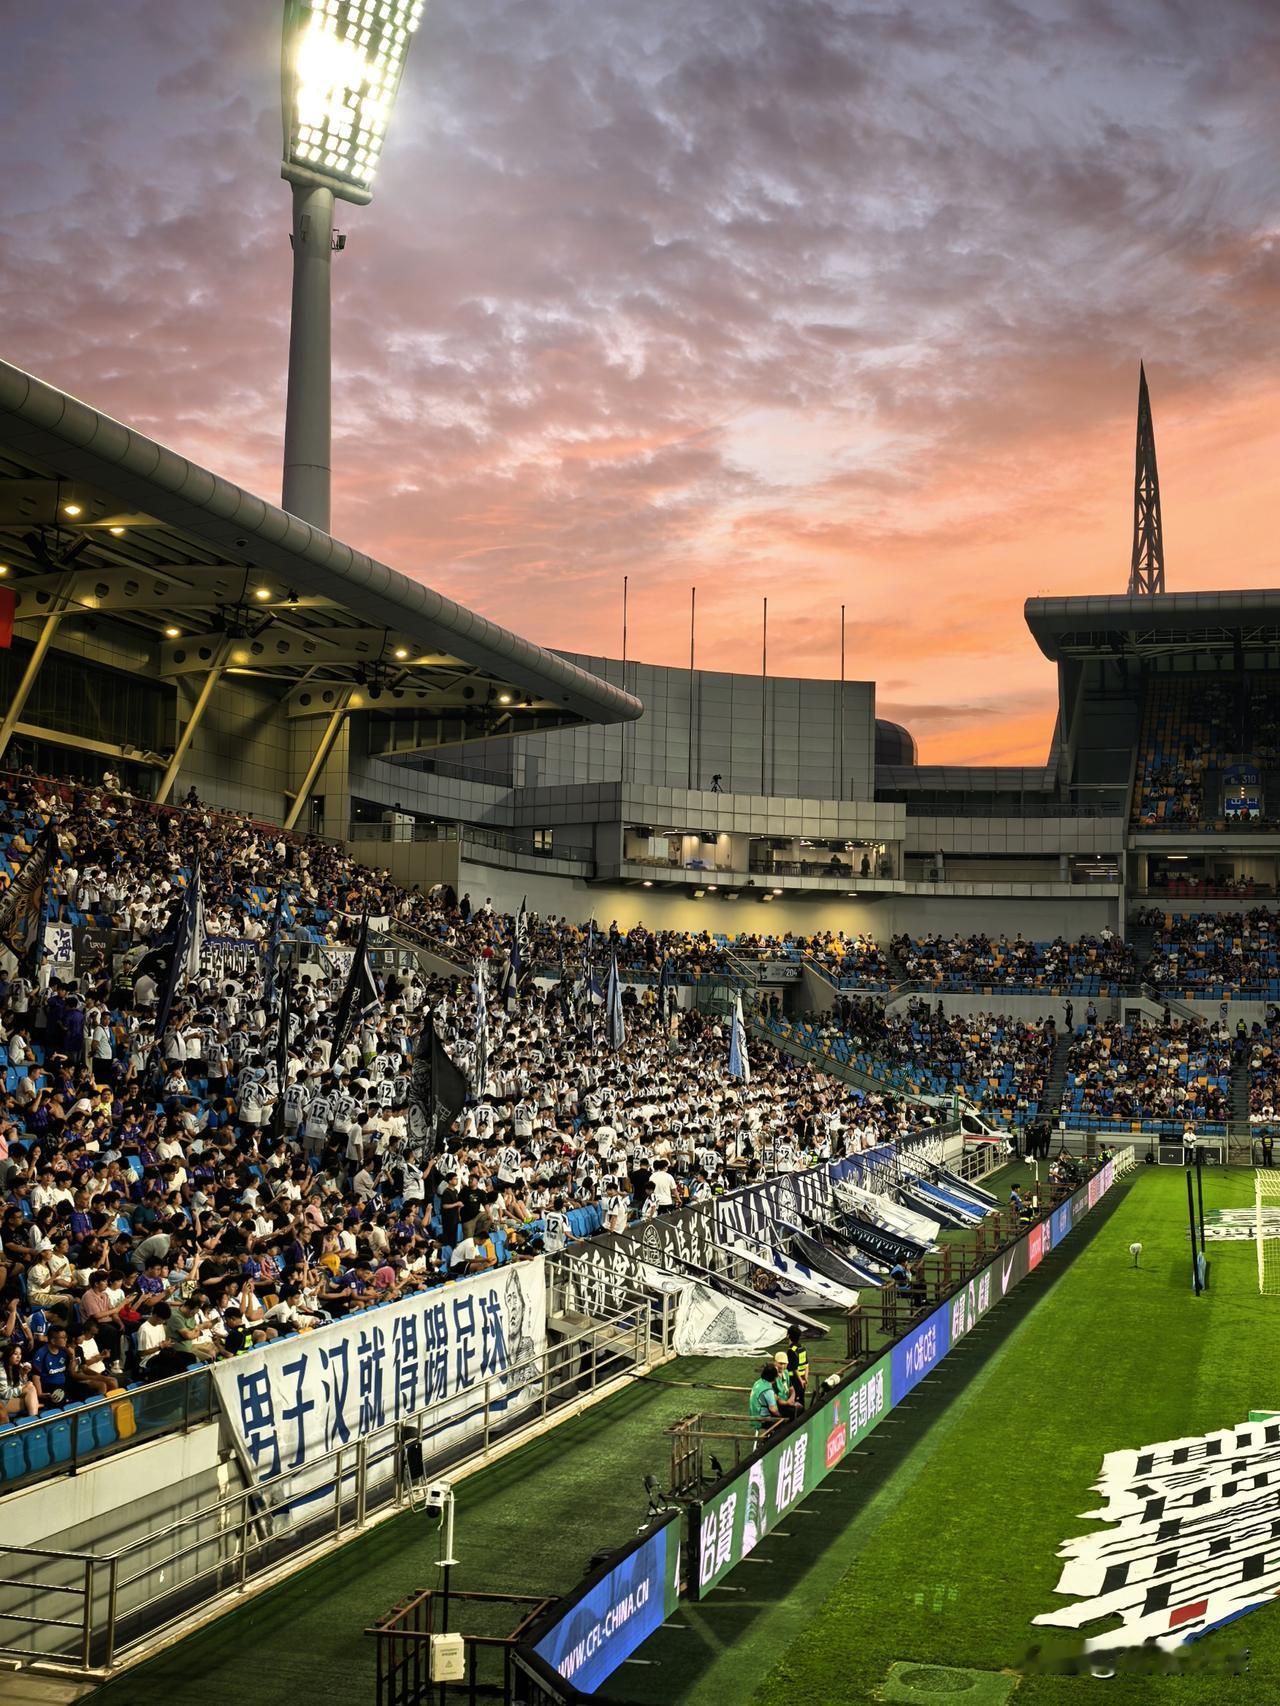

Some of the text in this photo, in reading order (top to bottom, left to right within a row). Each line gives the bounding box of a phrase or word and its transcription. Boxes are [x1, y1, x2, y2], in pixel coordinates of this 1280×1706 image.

[456, 1043, 465, 1055] 12
[243, 1087, 253, 1100] 12
[288, 1090, 301, 1104] 12
[382, 1086, 392, 1099] 12
[312, 1104, 326, 1119] 12
[338, 1100, 350, 1115] 12
[479, 1110, 490, 1123] 12
[516, 1109, 524, 1121] 12
[504, 1152, 514, 1166] 12
[705, 1155, 714, 1166] 12
[764, 1152, 774, 1162] 12
[547, 1218, 559, 1233] 12
[237, 1288, 508, 1482] 男子汉就得踢足球
